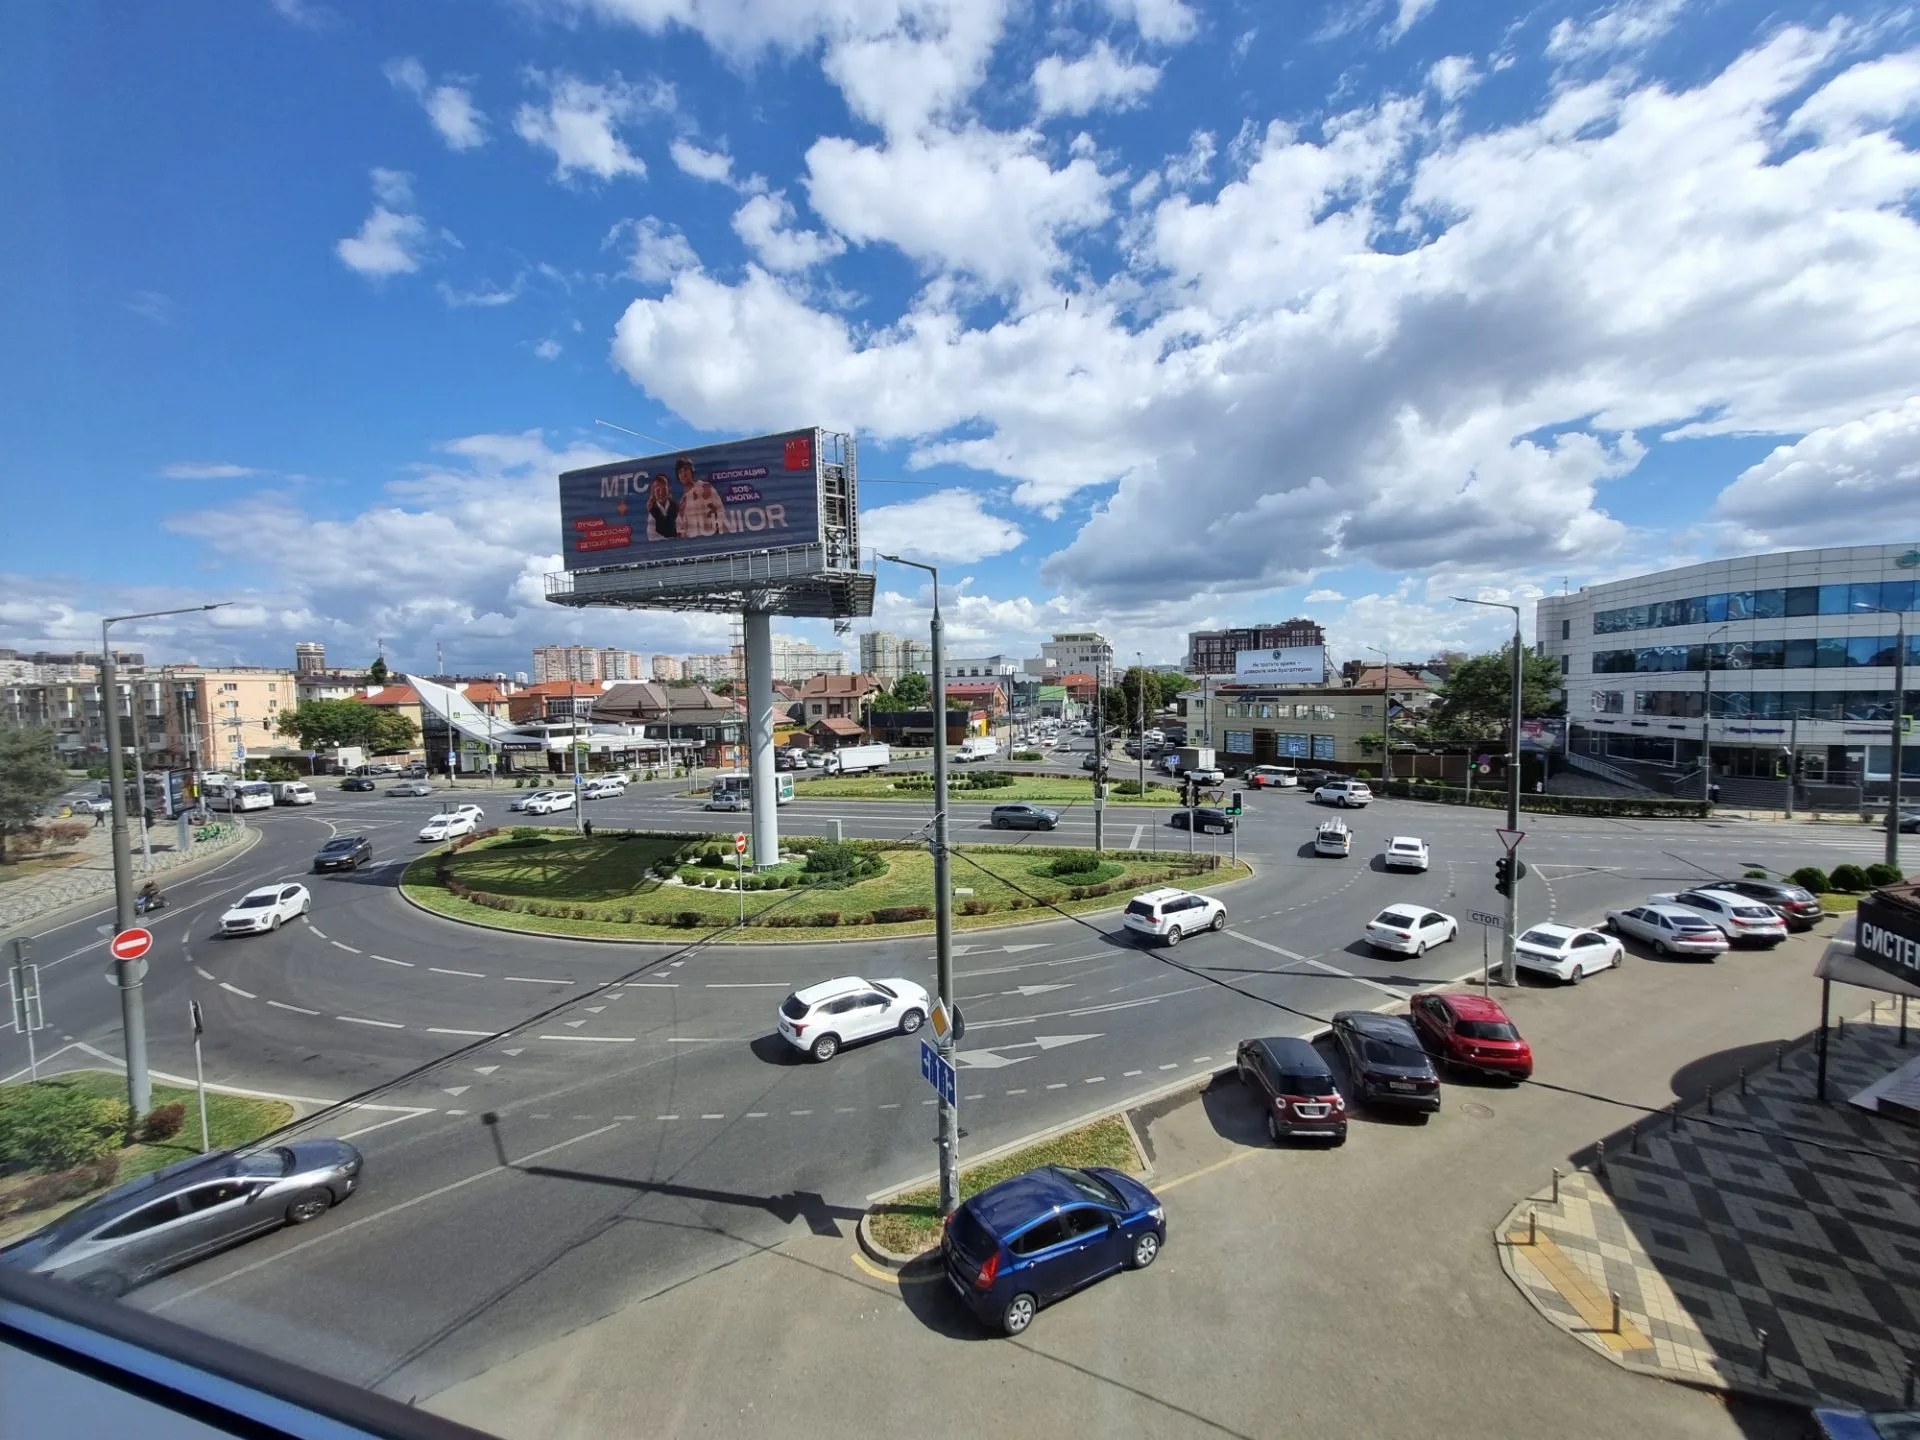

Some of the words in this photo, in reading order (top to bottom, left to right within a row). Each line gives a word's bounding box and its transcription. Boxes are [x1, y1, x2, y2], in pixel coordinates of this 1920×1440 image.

[712, 467, 766, 480] ГЕОЛОКАЦИЯ
[600, 471, 649, 498] МТС
[726, 492, 760, 501] КНОПКА
[1471, 912, 1500, 926] СТОП
